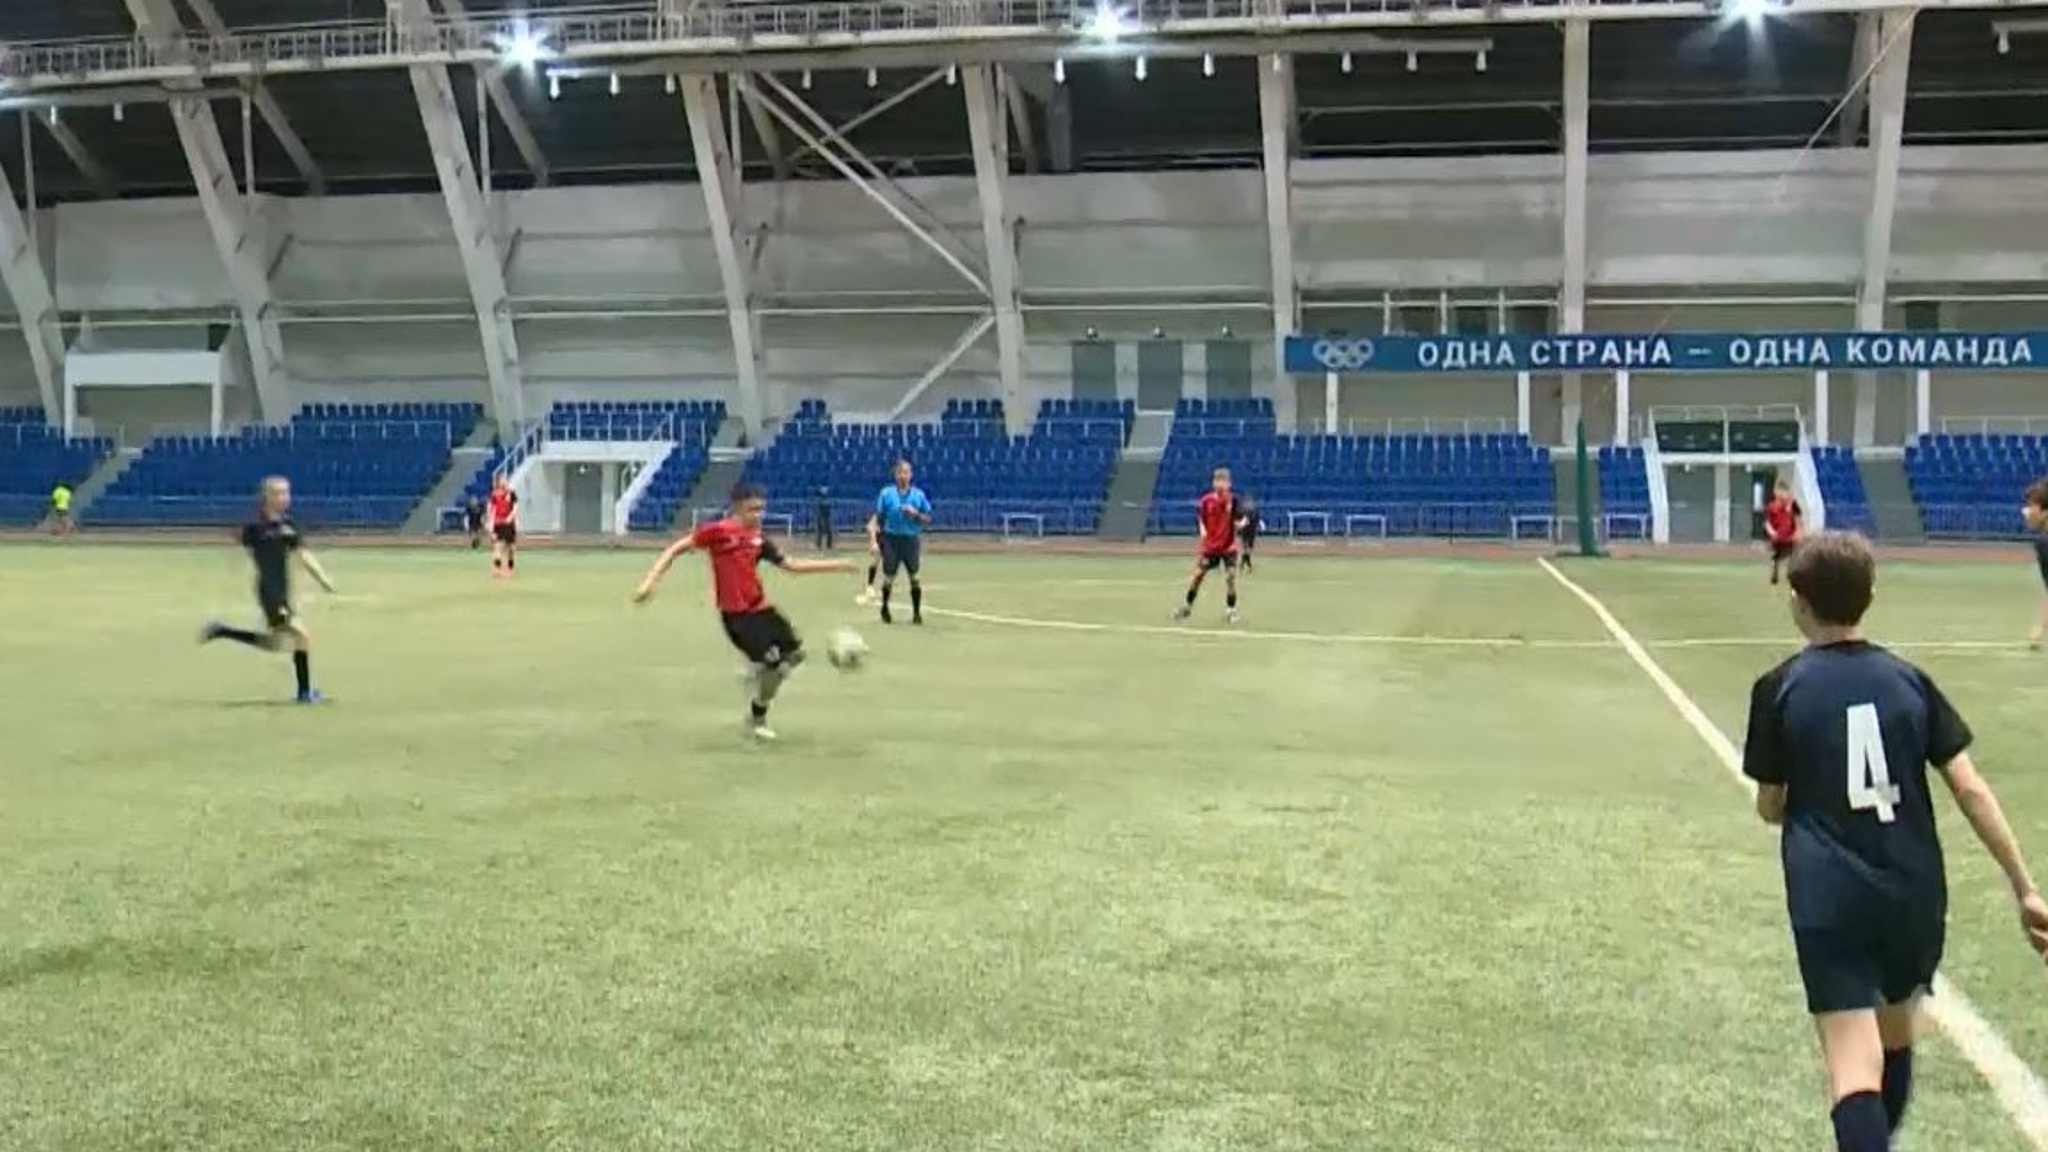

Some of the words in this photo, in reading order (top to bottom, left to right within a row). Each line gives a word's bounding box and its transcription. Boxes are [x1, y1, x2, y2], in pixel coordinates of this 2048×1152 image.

[1418, 341, 1516, 368] ОДНА
[1530, 339, 1672, 364] СТРАНА
[1729, 338, 1831, 366] ОДНА
[1846, 338, 2032, 365] КОМАНДА
[1847, 702, 1901, 822] 4
